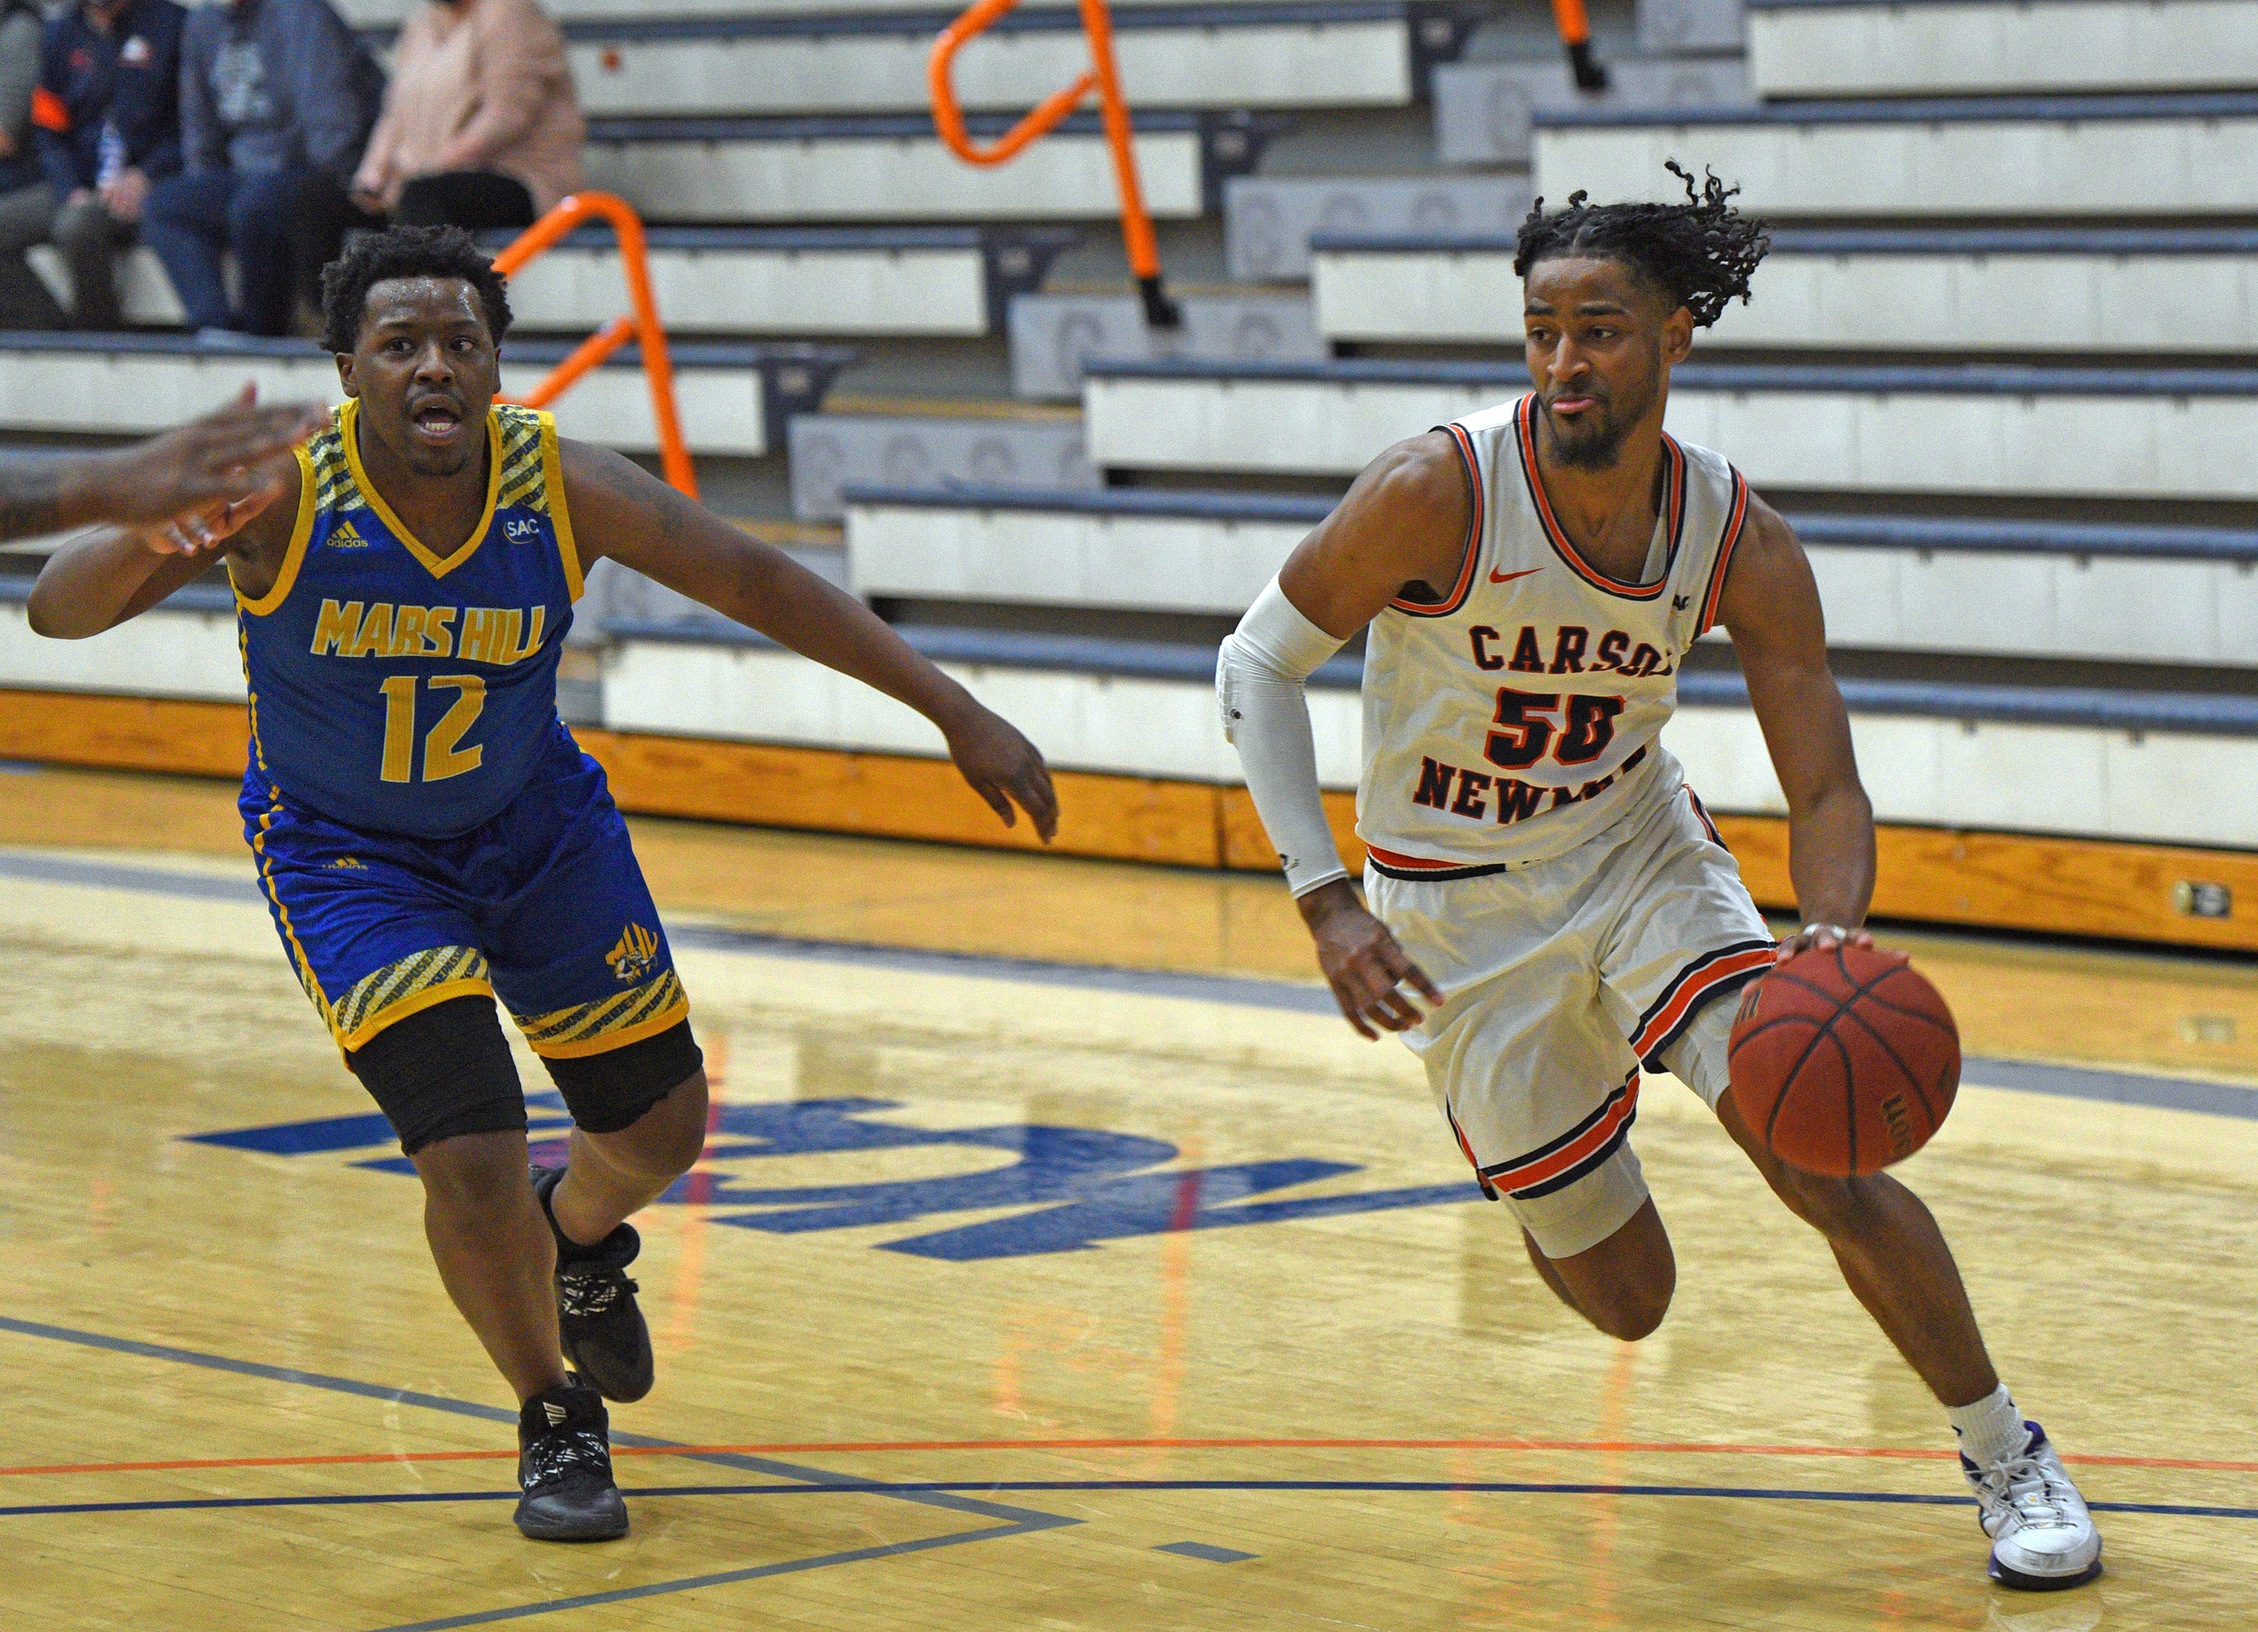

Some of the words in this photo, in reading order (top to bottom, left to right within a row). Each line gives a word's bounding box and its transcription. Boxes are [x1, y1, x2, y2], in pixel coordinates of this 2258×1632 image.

[327, 537, 369, 548] adidas
[507, 519, 540, 537] SAC
[310, 598, 457, 658] MARS
[456, 605, 546, 666] HILL
[1468, 625, 1673, 678] CARSO
[379, 674, 488, 784] 12
[1484, 686, 1628, 771] 50
